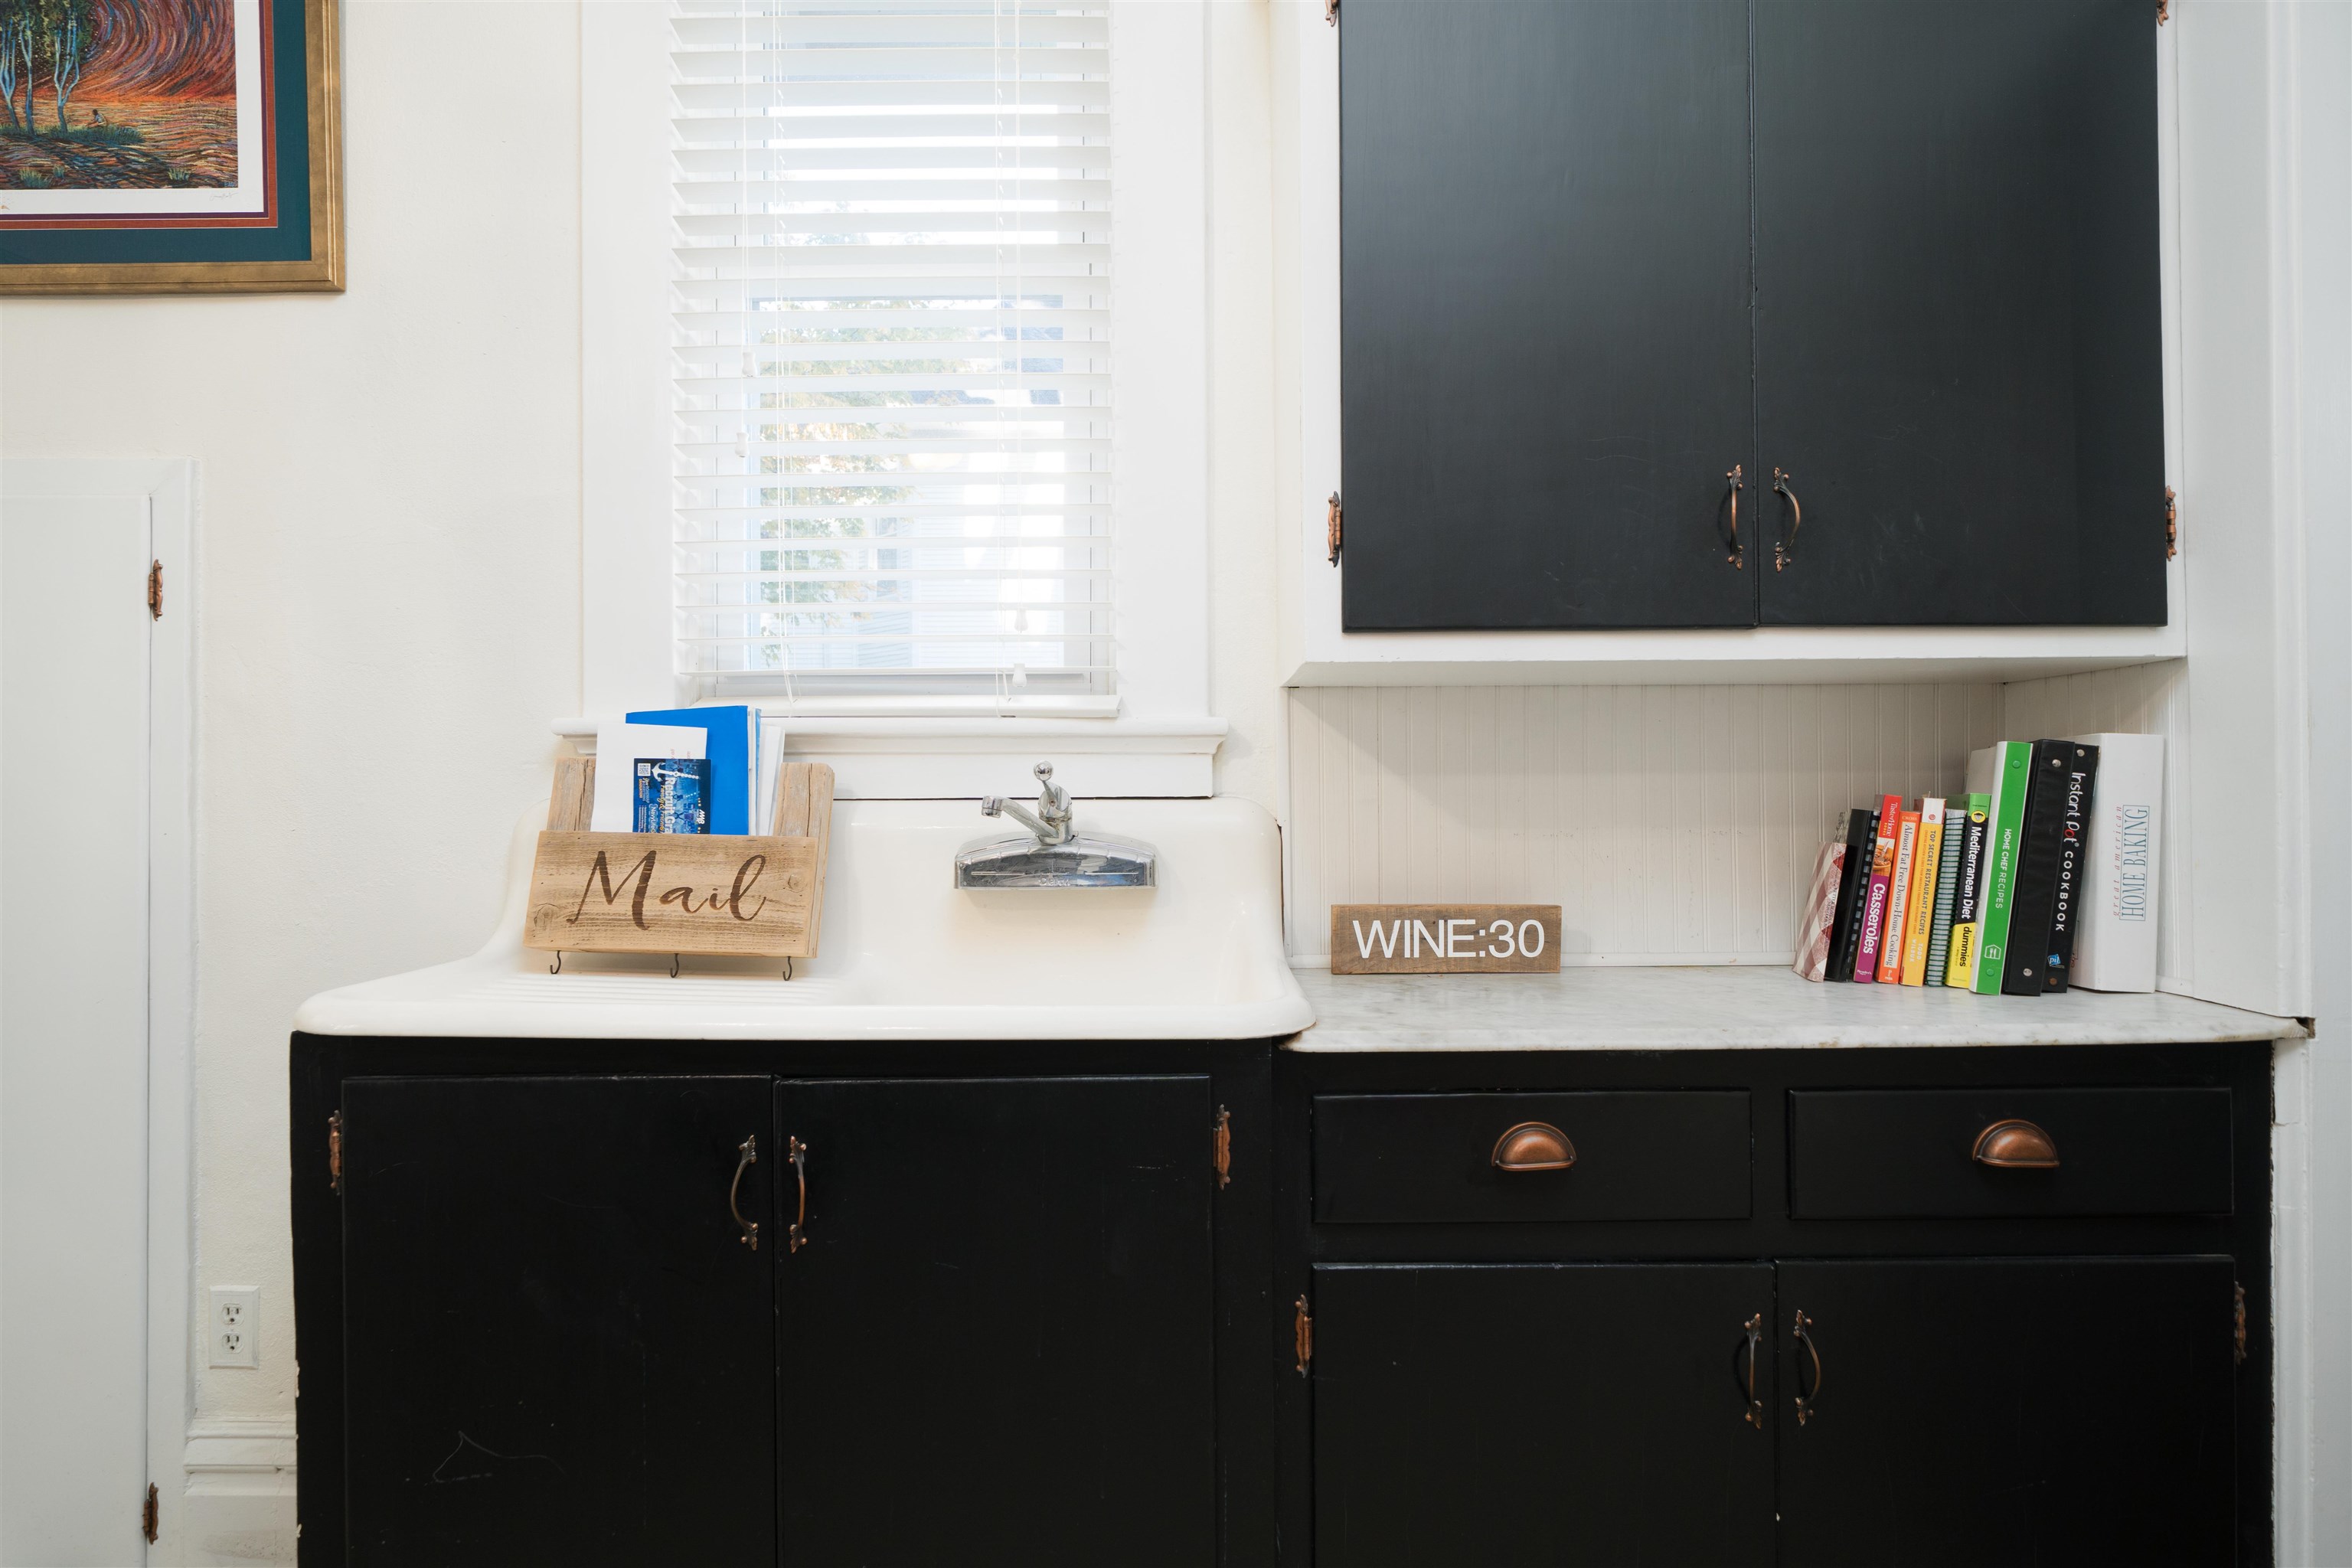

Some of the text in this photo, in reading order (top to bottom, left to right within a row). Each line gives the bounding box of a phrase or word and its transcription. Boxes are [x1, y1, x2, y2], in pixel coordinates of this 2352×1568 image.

[665, 777, 676, 815] Recruit
[2066, 772, 2086, 817] Instant
[1926, 844, 1935, 867] SECRET
[1962, 826, 1982, 920] Mediterranean Diet
[1995, 828, 2012, 909] HOME CHEF RECIPES
[2113, 806, 2122, 918] great american
[2121, 808, 2148, 918] HOME BAKING
[566, 851, 766, 931] Mail
[1886, 825, 1913, 966] Almost Fat Free Down-Home Cooking
[1922, 868, 1932, 910] RESTAURANT
[2055, 851, 2074, 932] COOKBOOK
[1352, 919, 1545, 959] WINE:30
[1863, 883, 1886, 955] Casseroles
[1918, 911, 1926, 935] RECIPES
[1959, 926, 1972, 967] dummies
[2050, 956, 2060, 964] pil
